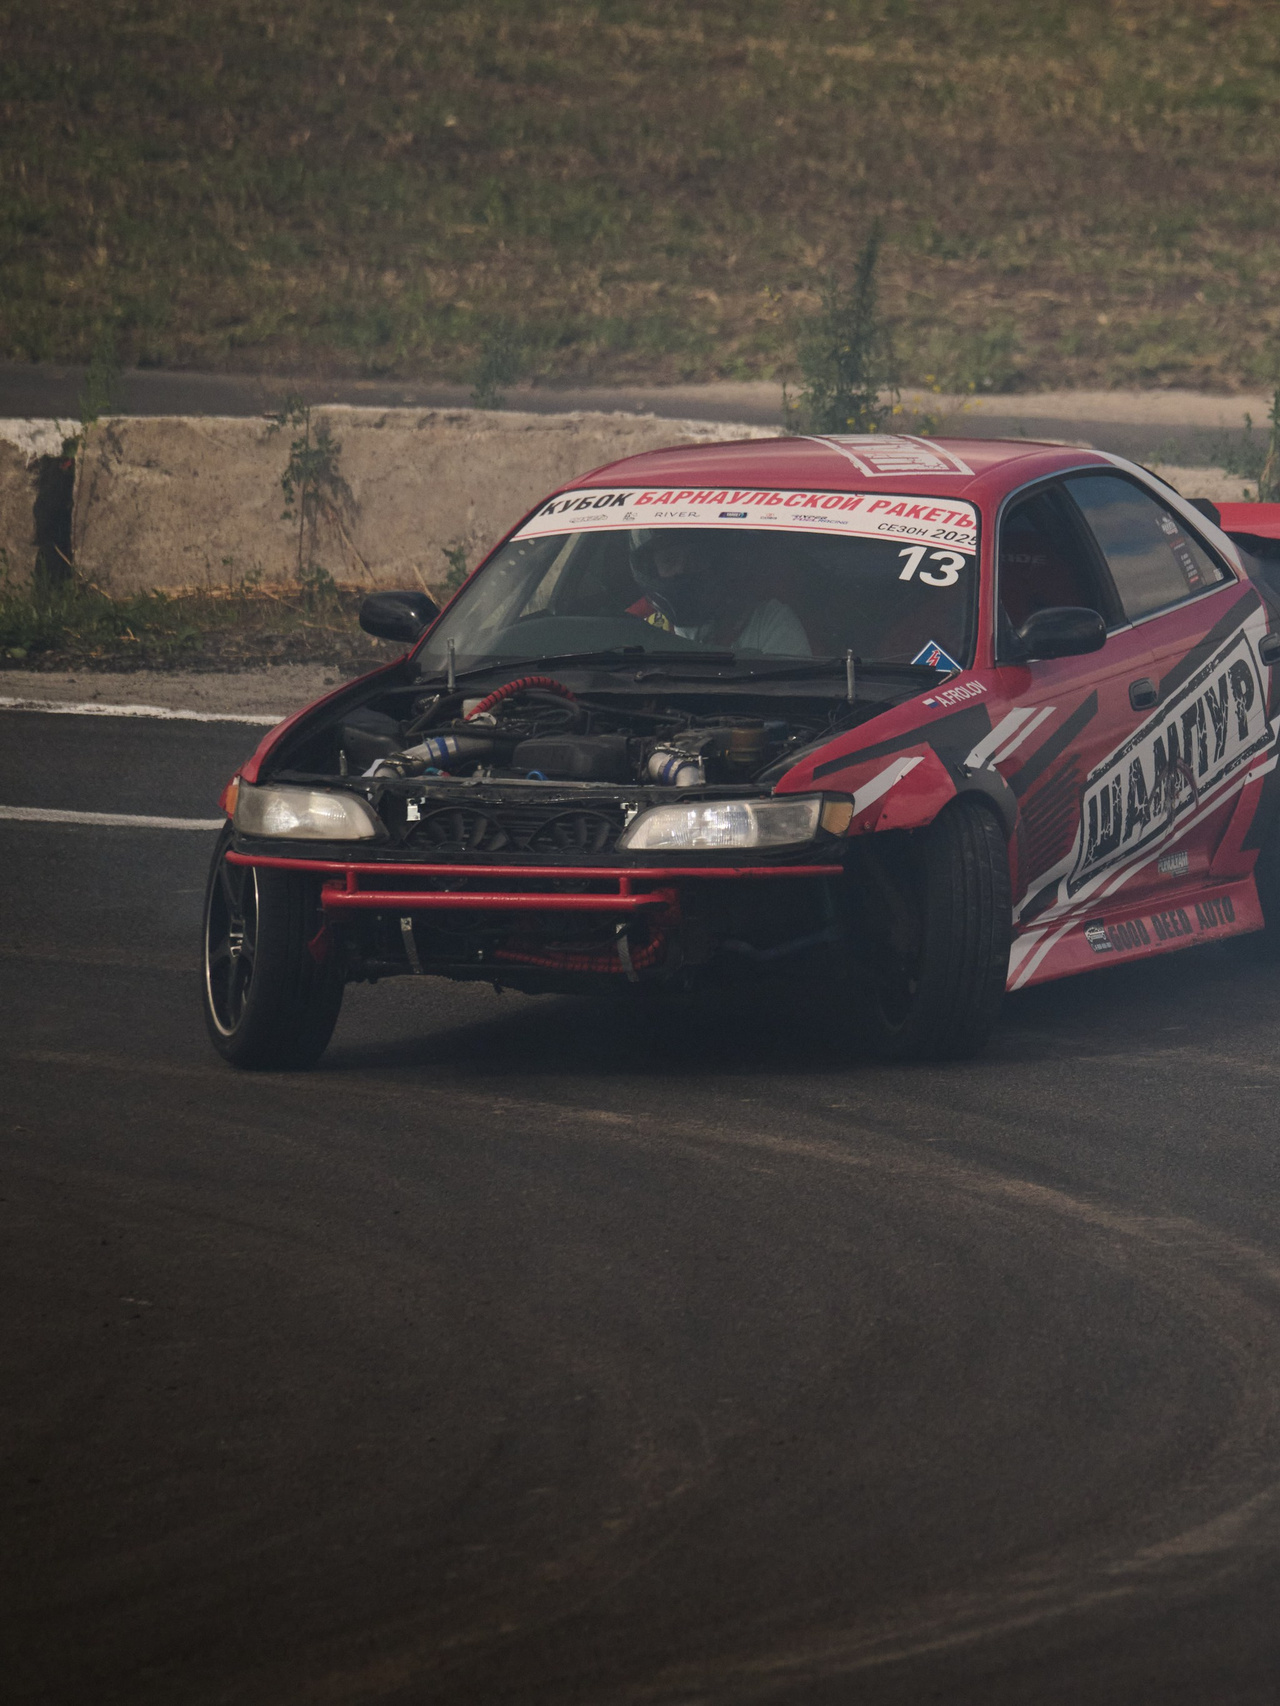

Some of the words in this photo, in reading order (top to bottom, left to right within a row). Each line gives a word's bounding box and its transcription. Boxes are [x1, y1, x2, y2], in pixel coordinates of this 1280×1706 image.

[539, 492, 634, 516] КУБОК
[633, 490, 865, 511] БАРНАУЛЬСКОЙ
[877, 522, 928, 537] СЕЗОН
[930, 528, 977, 546] 2025
[898, 545, 966, 587] 13
[1082, 659, 1255, 871] ШАМПУР
[1108, 918, 1151, 952] GOOD
[1194, 895, 1236, 931] AUTO
